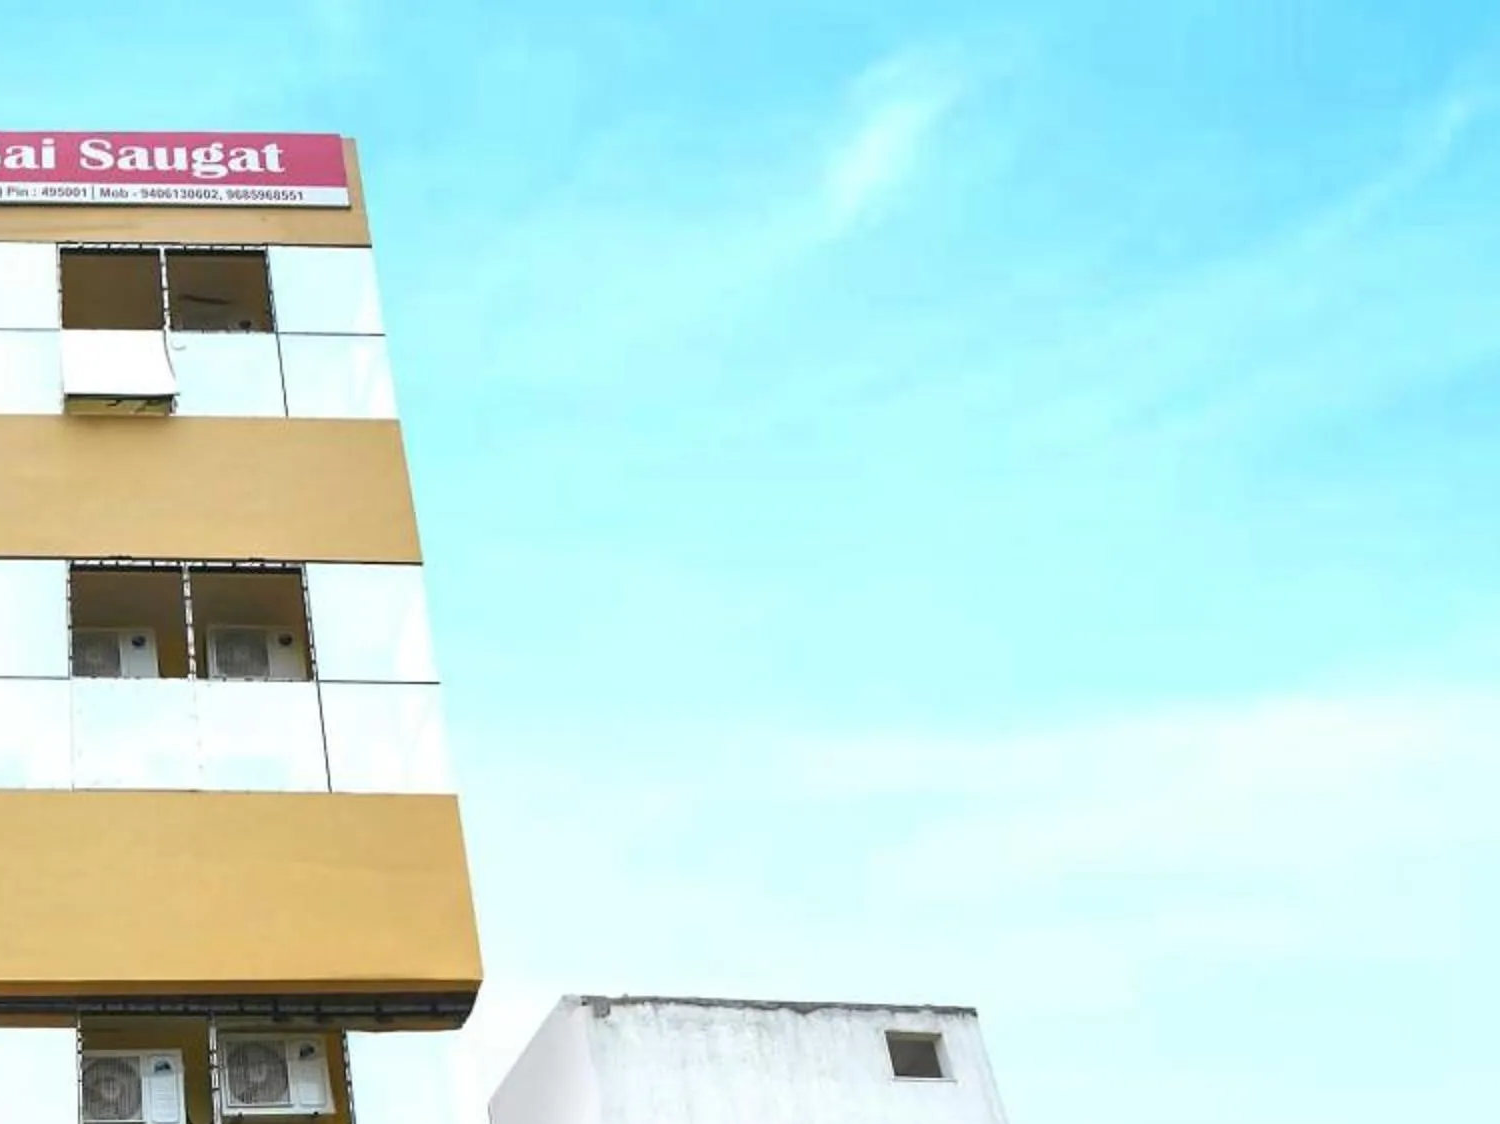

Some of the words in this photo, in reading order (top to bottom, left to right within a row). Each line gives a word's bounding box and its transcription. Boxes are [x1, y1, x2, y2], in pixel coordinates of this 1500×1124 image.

[78, 138, 286, 179] Saugat
[6, 186, 29, 197] Pin
[99, 188, 129, 198] Mob
